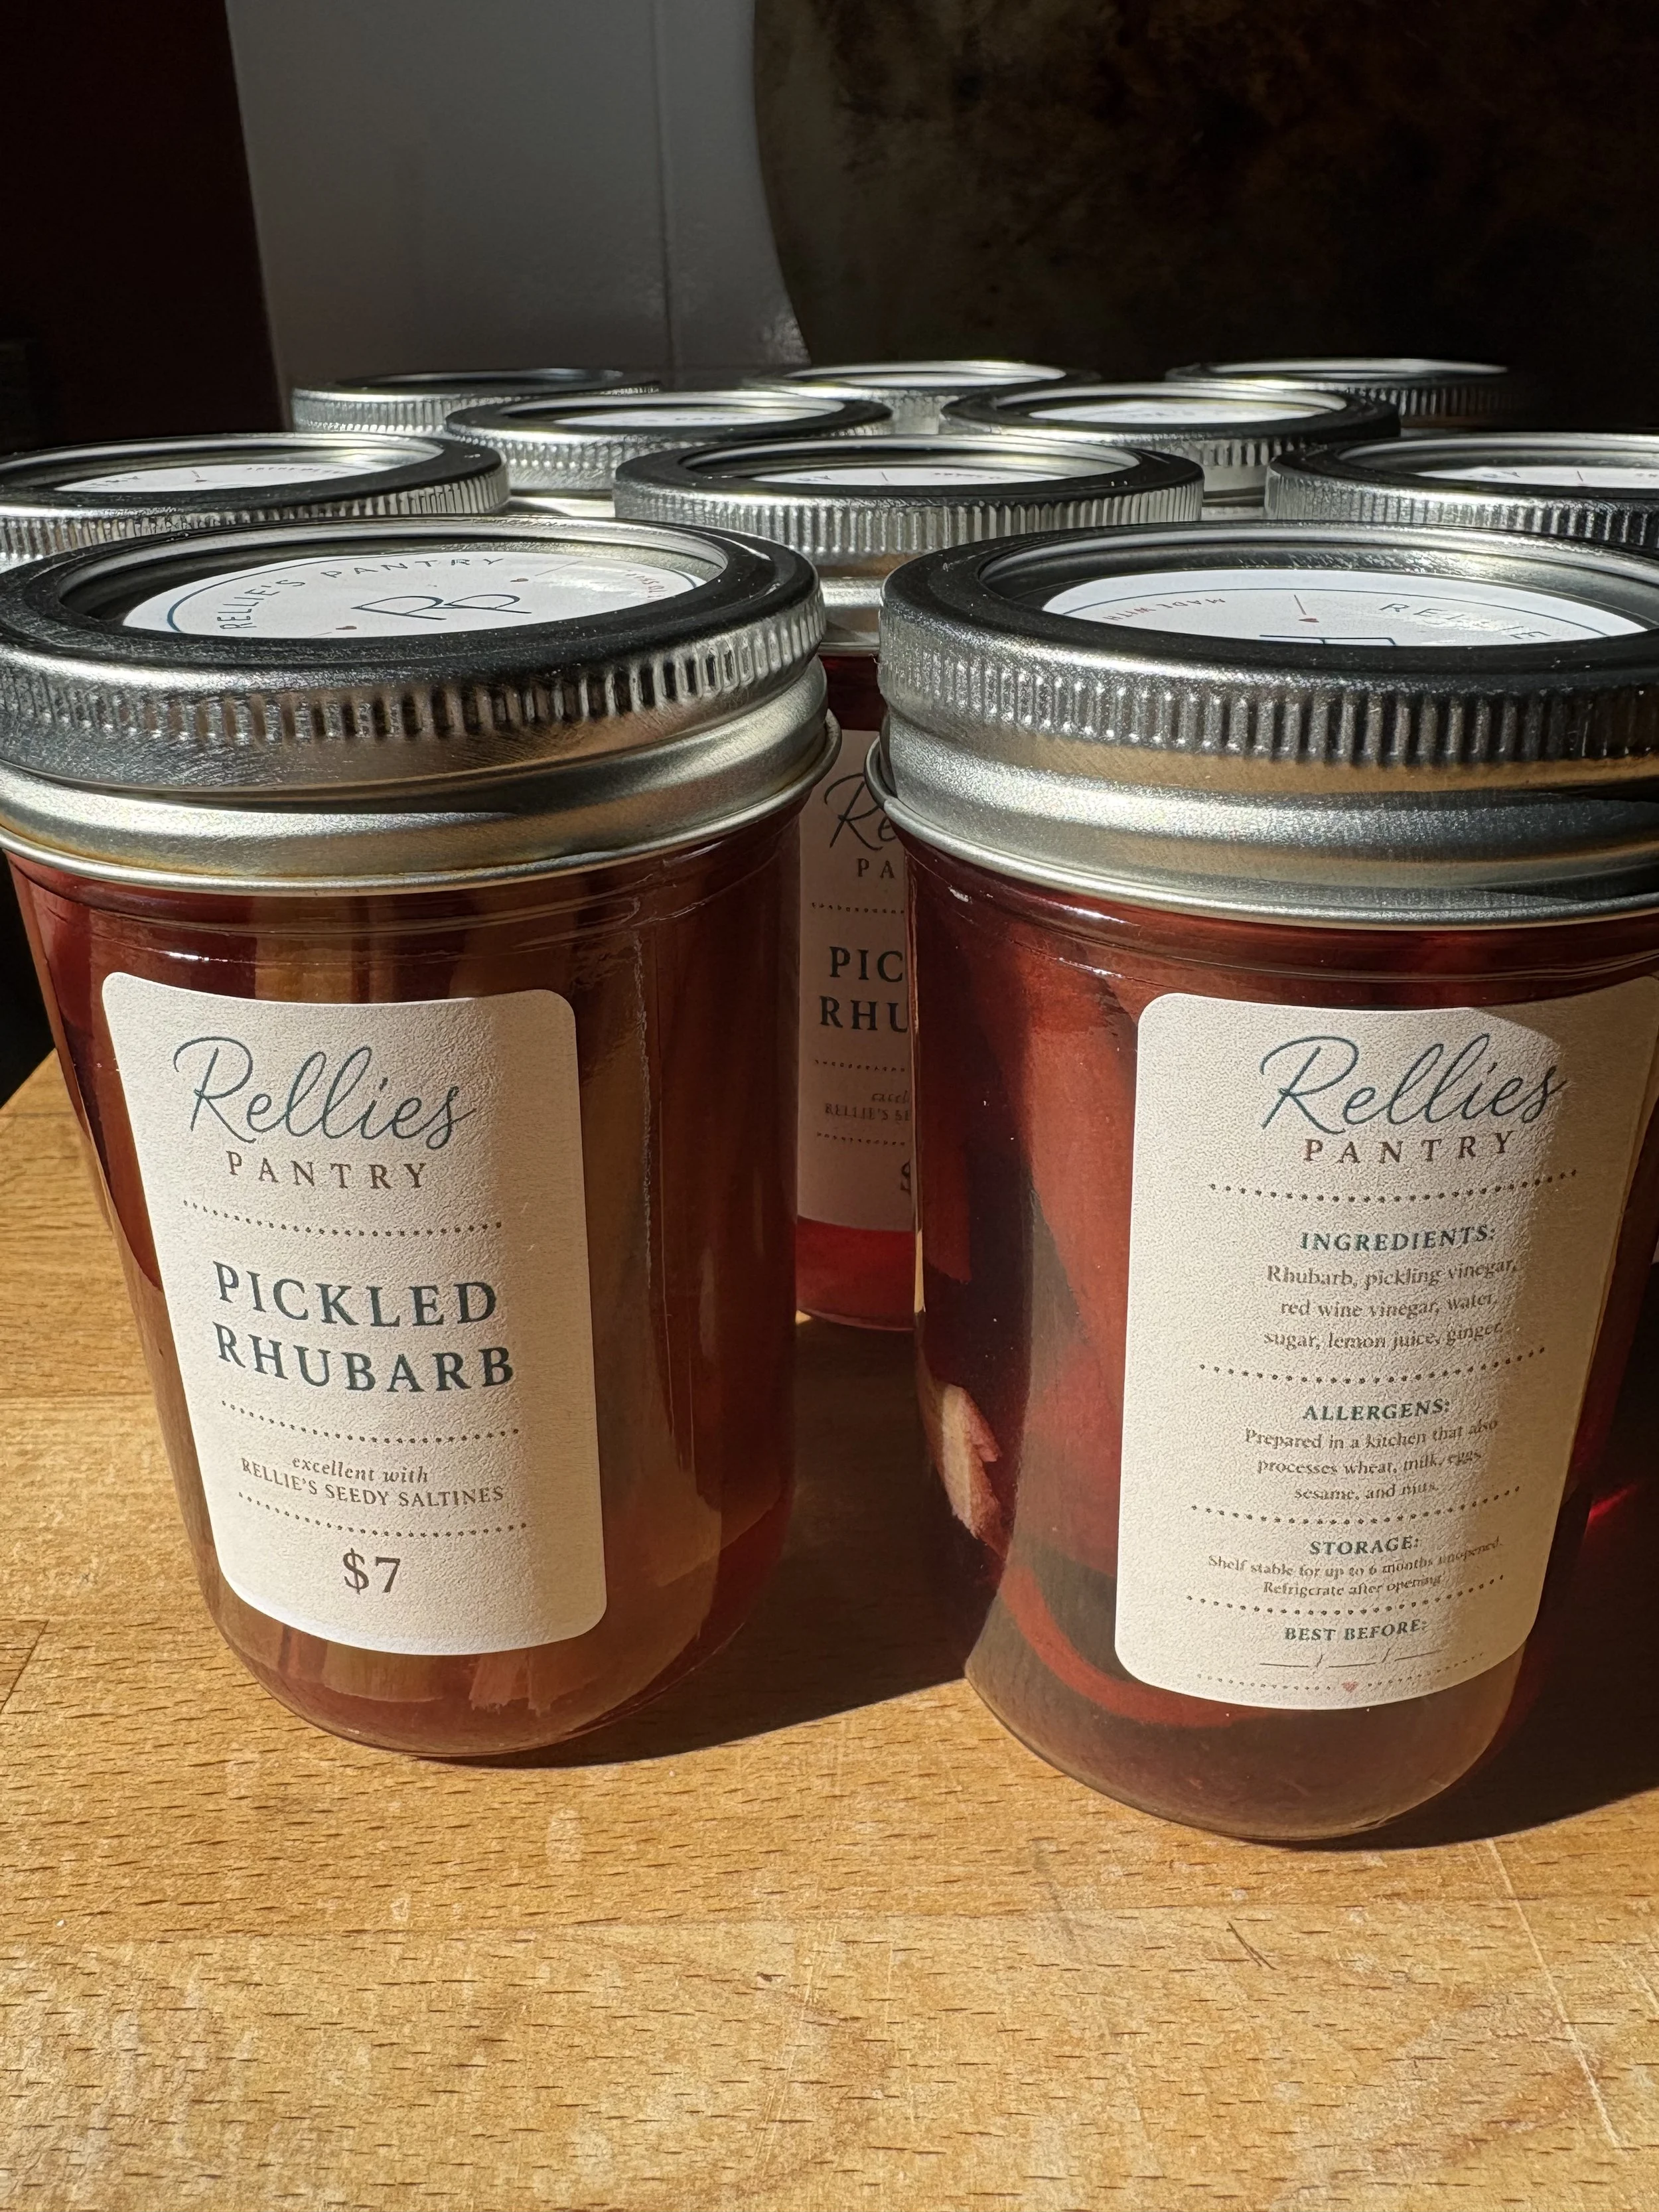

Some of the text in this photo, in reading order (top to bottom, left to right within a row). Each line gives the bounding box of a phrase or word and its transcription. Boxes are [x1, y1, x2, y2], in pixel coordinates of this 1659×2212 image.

[216, 557, 504, 629] RELLIE'S PANTRY
[174, 1036, 478, 1149] Rellies
[1261, 1032, 1567, 1135] Rellies
[1304, 1130, 1517, 1164] PANTRY
[226, 1150, 427, 1189] PANTRY
[1299, 1224, 1495, 1251] INGREDIENTS:
[1267, 1265, 1358, 1288] Rhubarb,
[1364, 1266, 1443, 1290] pickling
[213, 1260, 497, 1328] PICKLED
[1279, 1299, 1311, 1315] red
[1317, 1301, 1363, 1318] wine
[1368, 1301, 1440, 1320] vinegar,
[1263, 1331, 1320, 1351] sugar,
[1328, 1331, 1386, 1350] lemon
[1392, 1330, 1440, 1351] juice,
[212, 1321, 514, 1393] RHUBARB
[1303, 1398, 1450, 1421] ALLERGENS:
[1245, 1418, 1498, 1449] Prepared in a kitchen that also
[292, 1457, 428, 1483] excellent with
[1258, 1459, 1338, 1474] processes
[241, 1457, 505, 1507] RELLIE'S SEEDY SALTINES
[1364, 1483, 1396, 1500] and
[1309, 1536, 1419, 1555] STORAGE:
[342, 1547, 401, 1595] $7
[1208, 1554, 1248, 1572] Shelf
[1250, 1563, 1294, 1576] stable
[1299, 1564, 1321, 1578] for
[1325, 1567, 1344, 1580] up
[1349, 1566, 1364, 1577] to
[1368, 1565, 1377, 1576] 6
[1382, 1556, 1433, 1574] months
[1263, 1581, 1344, 1598] Refrigerate
[1348, 1582, 1384, 1595] after
[1285, 1618, 1428, 1641] BEST BEFORE:
